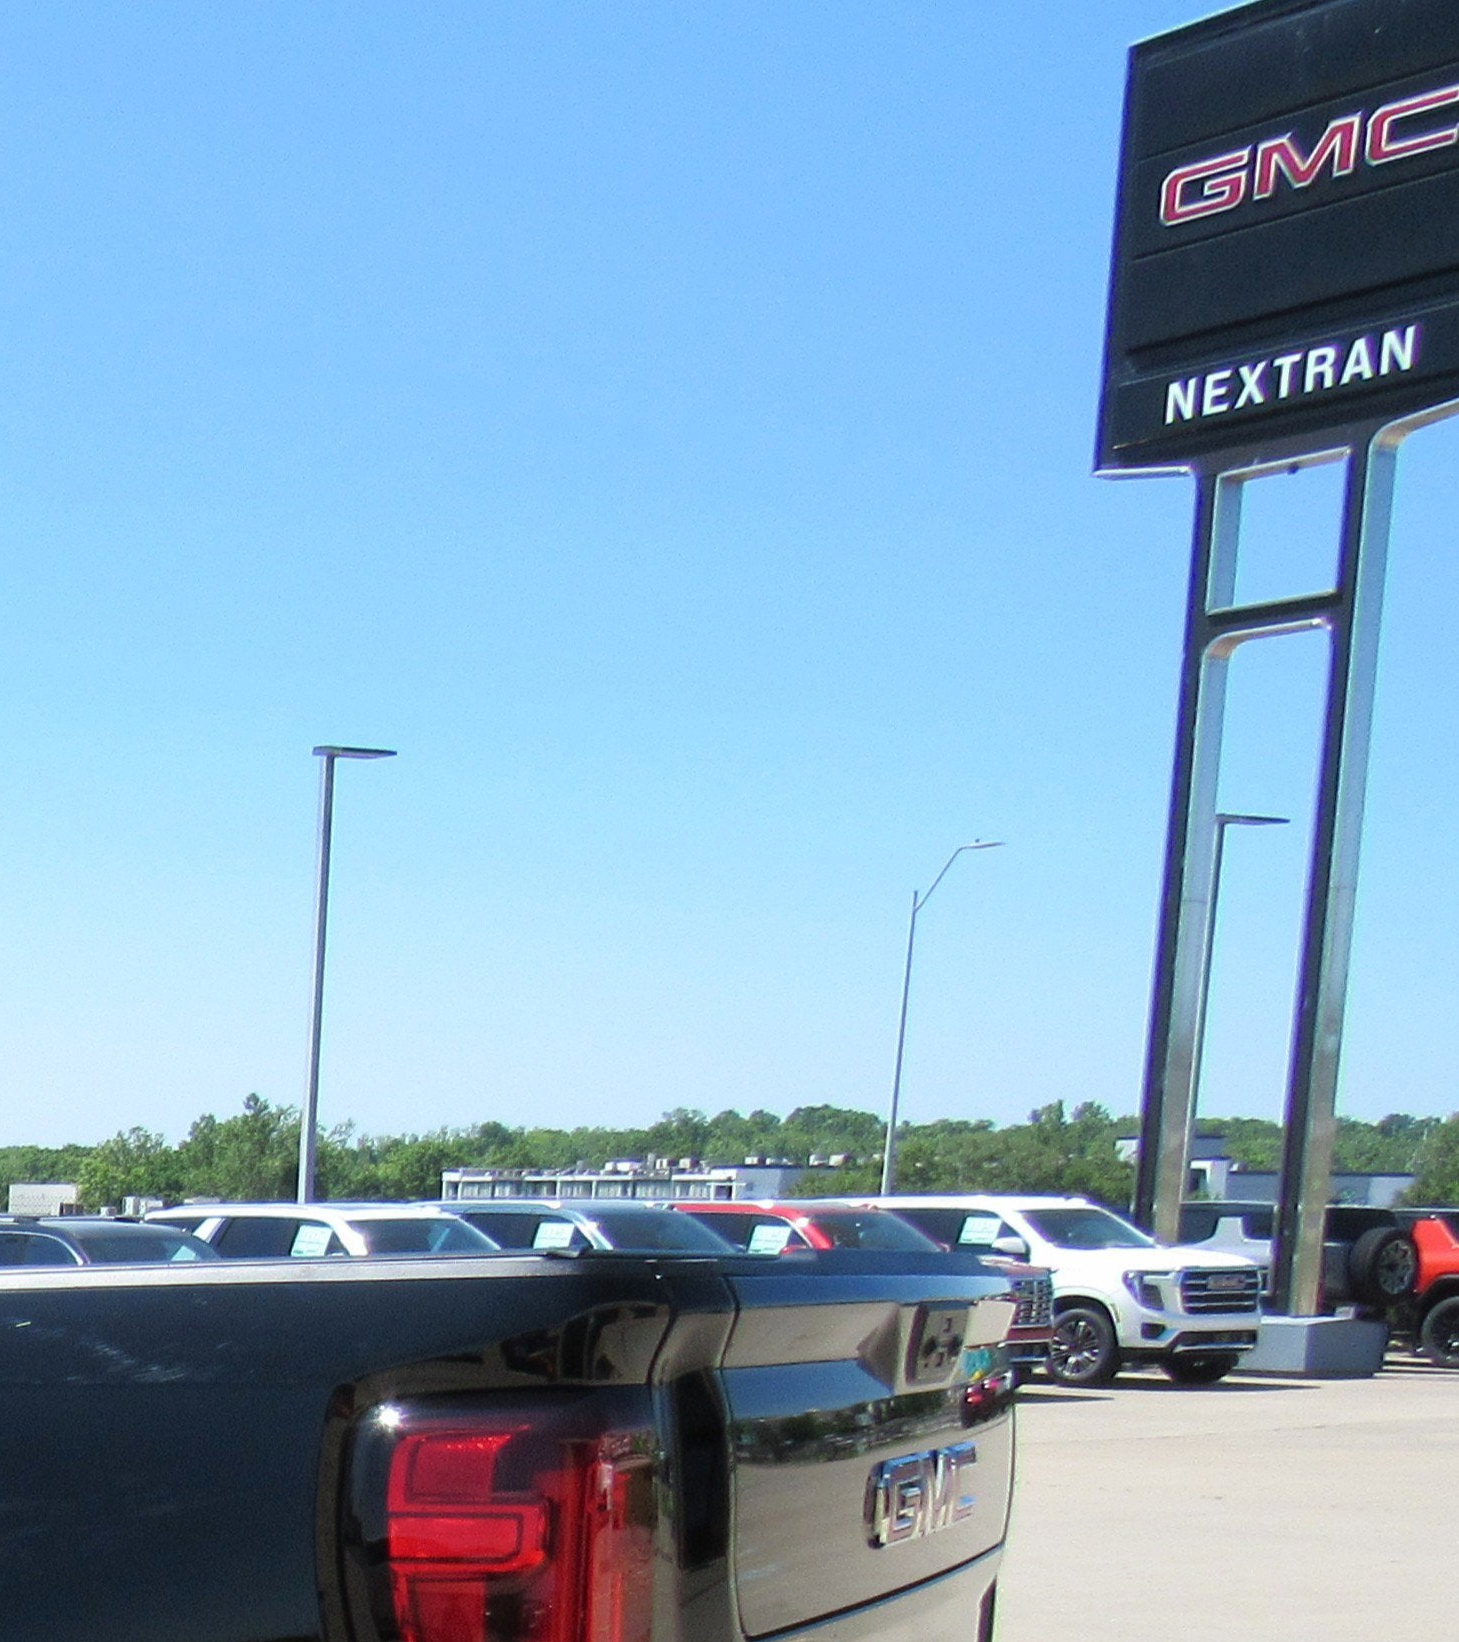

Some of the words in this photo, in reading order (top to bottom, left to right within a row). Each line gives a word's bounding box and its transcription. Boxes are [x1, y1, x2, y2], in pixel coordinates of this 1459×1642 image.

[1159, 83, 1459, 226] GMC
[1165, 325, 1417, 425] NEXTRAN
[865, 1442, 976, 1548] GMC
